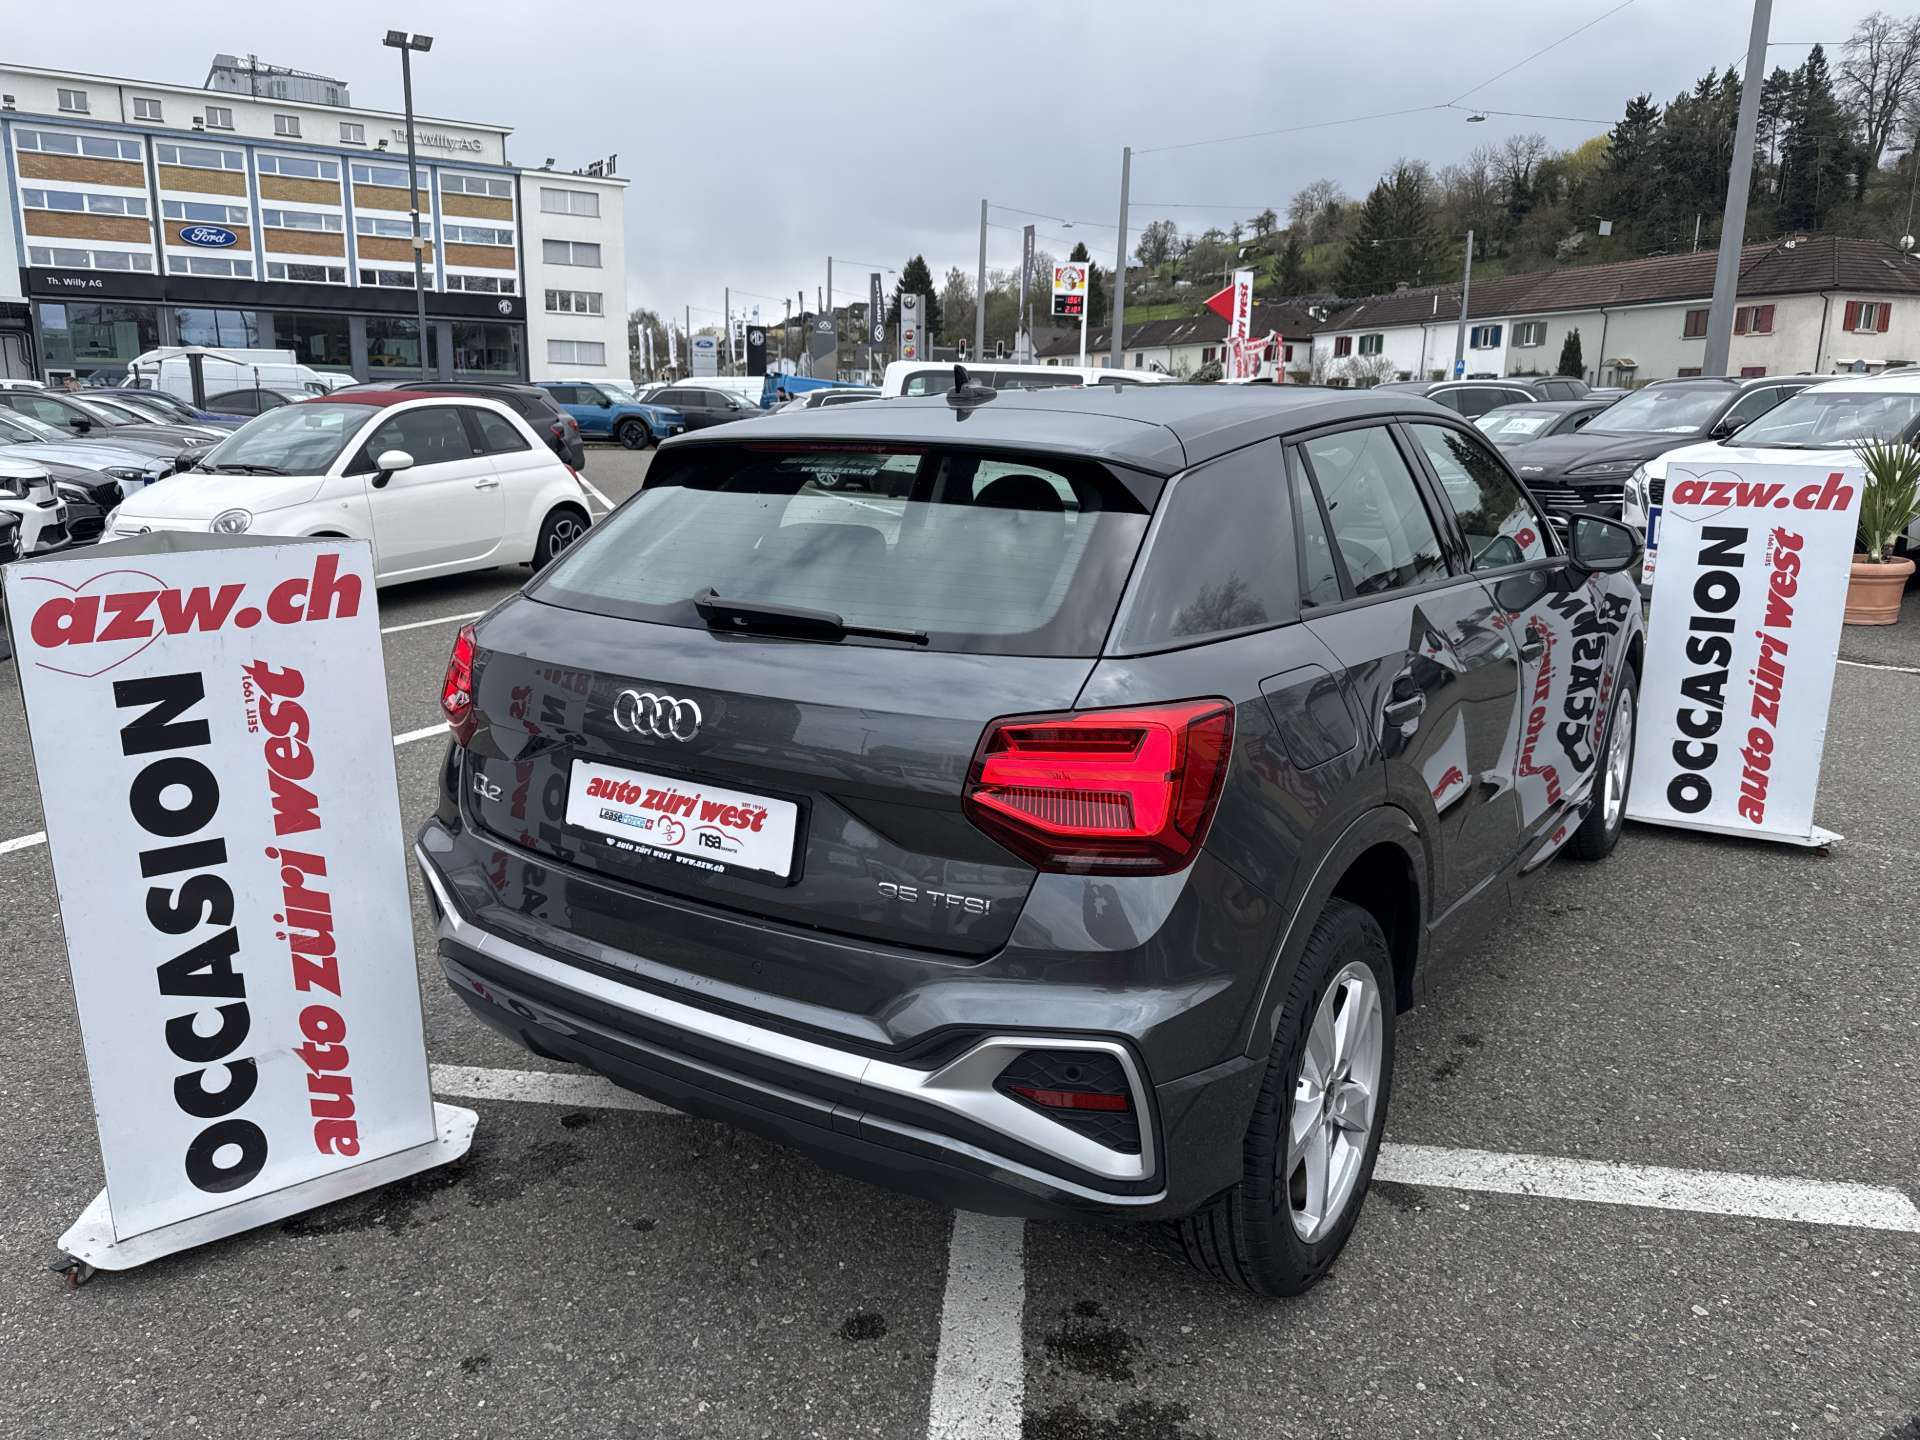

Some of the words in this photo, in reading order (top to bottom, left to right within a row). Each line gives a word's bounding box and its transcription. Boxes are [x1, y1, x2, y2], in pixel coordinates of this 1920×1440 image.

[421, 131, 458, 151] Willy
[461, 138, 482, 152] AG
[1785, 240, 1796, 249] 48
[46, 277, 61, 286] Th.
[63, 278, 86, 289] Willy
[89, 279, 103, 288] AG
[1672, 472, 1854, 511] azw.ch
[31, 553, 362, 648] azw.ch
[1763, 526, 1804, 629] west
[242, 675, 255, 704] 1991
[1666, 526, 1749, 814] OCCASION
[1748, 630, 1789, 729] züri
[246, 708, 259, 733] SEIT
[240, 659, 322, 837] west
[473, 772, 502, 802] Q2
[1738, 727, 1774, 825] auto
[586, 778, 642, 805] auto
[640, 788, 702, 818] züri
[700, 800, 768, 832] west
[616, 840, 634, 851] auto
[634, 844, 652, 855] züri
[652, 849, 673, 861] west
[675, 855, 725, 873] www.azw.ch
[699, 832, 722, 850] nsa
[877, 881, 918, 903] 35
[926, 890, 991, 916] TFSI
[112, 672, 269, 1194] OCCASION
[265, 846, 342, 998] züri
[292, 1004, 361, 1157] auto
